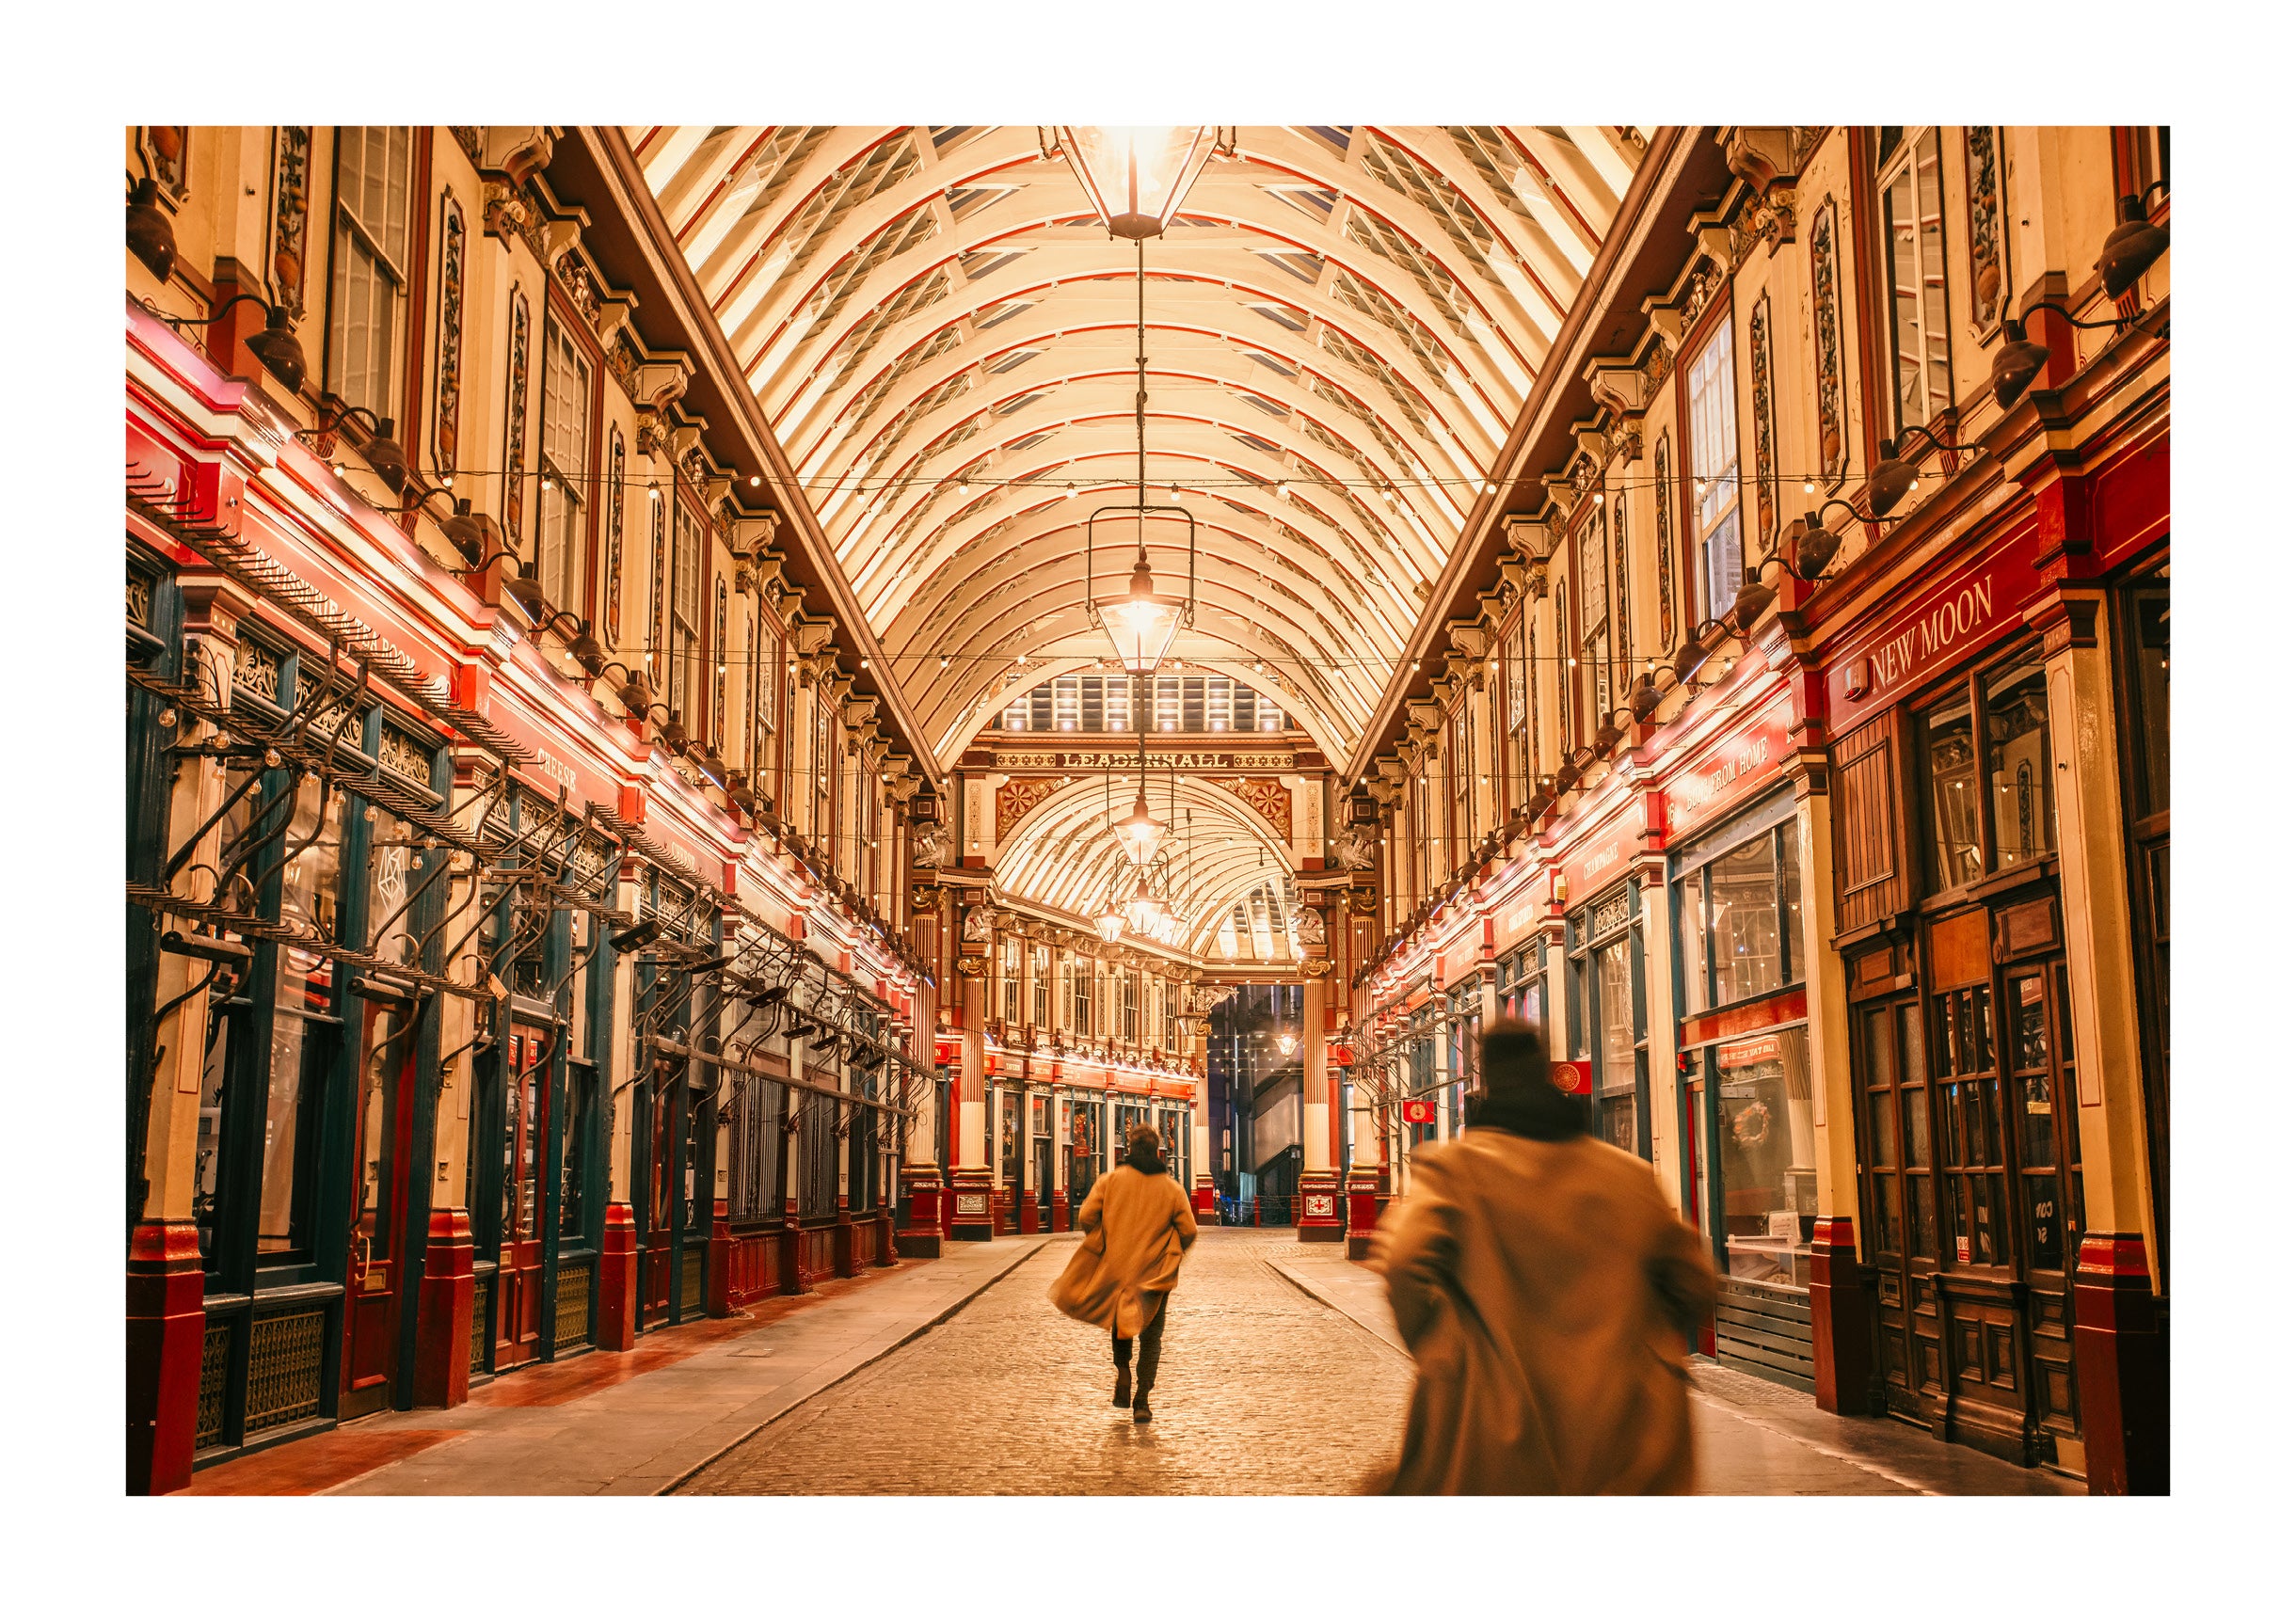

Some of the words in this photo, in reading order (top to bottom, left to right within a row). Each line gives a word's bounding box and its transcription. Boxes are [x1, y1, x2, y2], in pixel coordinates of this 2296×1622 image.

[1871, 626, 1917, 694] NEW
[1920, 574, 1992, 660] MOON
[537, 747, 577, 793] CHEESE
[1062, 754, 1228, 768] LEADENHALL
[1711, 759, 1736, 793] FROM
[1739, 736, 1768, 776] HOME
[1583, 841, 1618, 881] CHAMPAGNE
